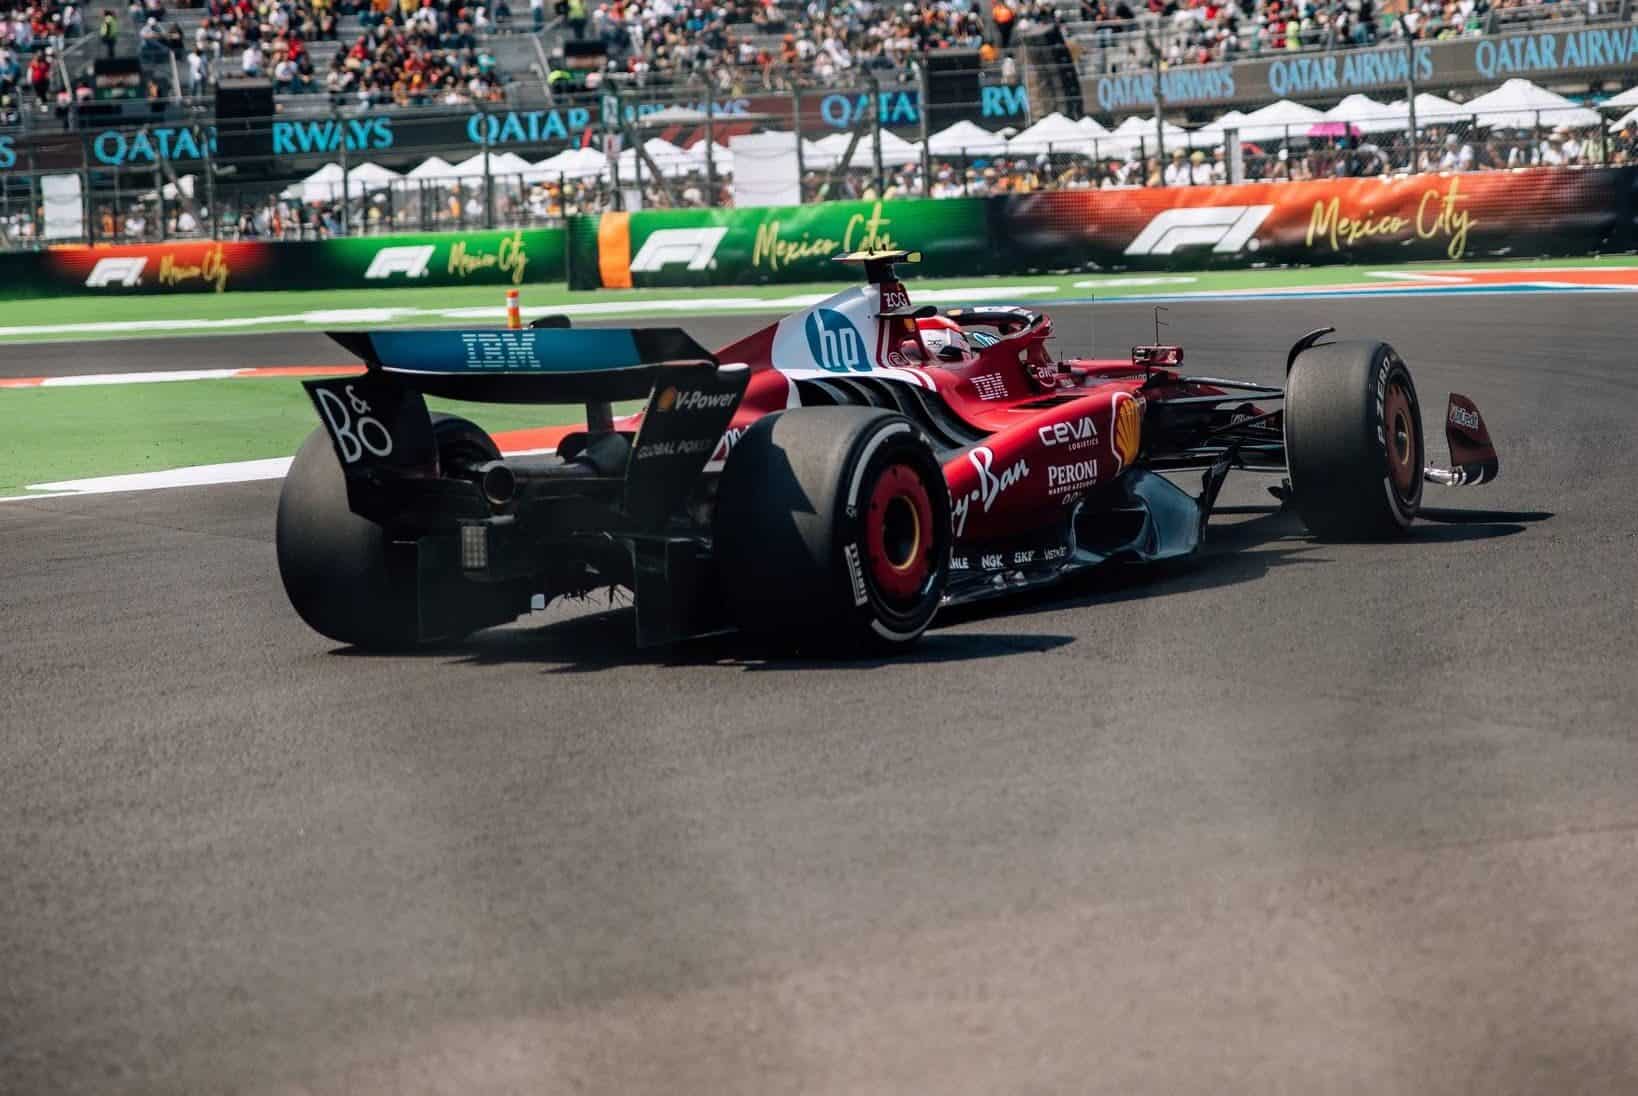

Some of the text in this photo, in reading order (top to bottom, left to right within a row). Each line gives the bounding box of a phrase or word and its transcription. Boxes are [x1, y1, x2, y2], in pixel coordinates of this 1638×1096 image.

[1476, 35, 1558, 79] QATAR
[1098, 74, 1155, 113] QATAR
[1269, 58, 1338, 96] QATAR
[1124, 176, 1477, 259] F1 Mexico City
[629, 226, 729, 272] F1
[753, 220, 840, 272] Mexico
[462, 333, 541, 368] IBM
[674, 390, 738, 411] V-Power
[1048, 458, 1098, 487] PERONI
[981, 554, 1005, 569] NGK
